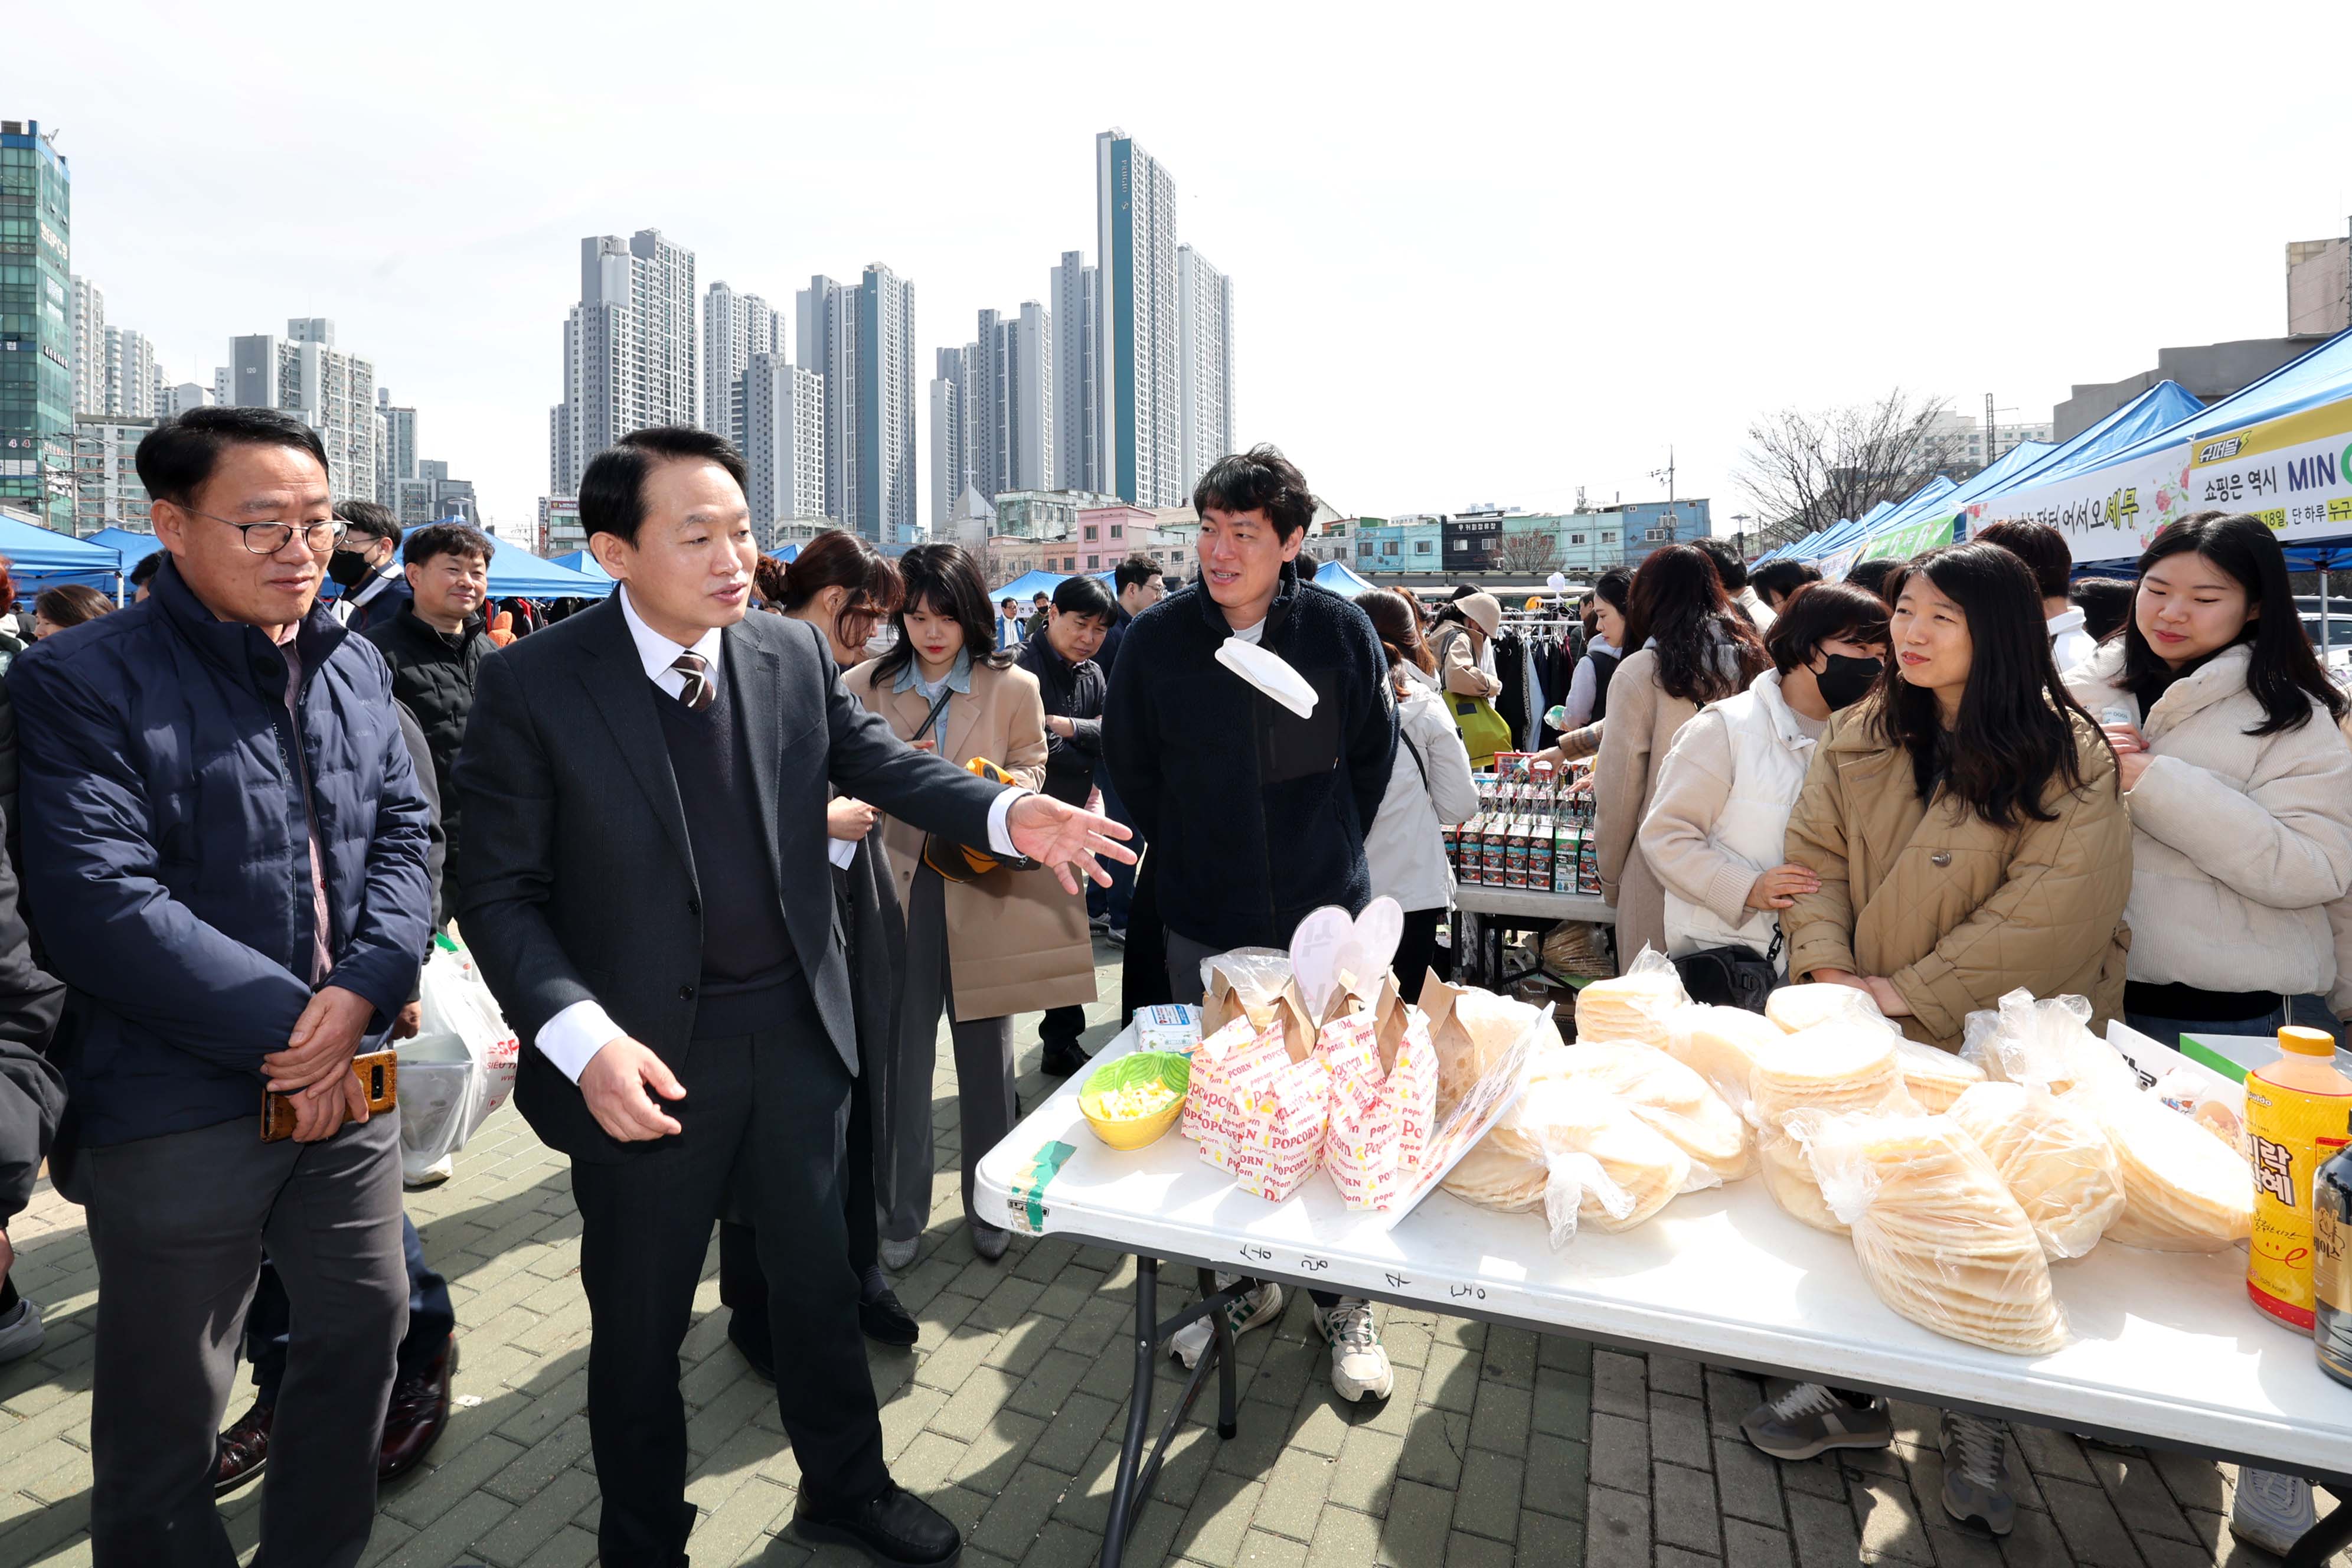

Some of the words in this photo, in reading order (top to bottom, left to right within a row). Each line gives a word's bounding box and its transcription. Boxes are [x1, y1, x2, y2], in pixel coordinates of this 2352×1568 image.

[2199, 437, 2242, 463] 슈퍼딜
[2204, 473, 2243, 502] 쇼핑은
[2248, 466, 2277, 496] 역시
[2292, 507, 2302, 525] 단
[2304, 504, 2326, 524] 하루
[1272, 1123, 1319, 1149] POPCORN
[1273, 1157, 1309, 1176] POPCORN
[1263, 1175, 1291, 1188] popcorn
